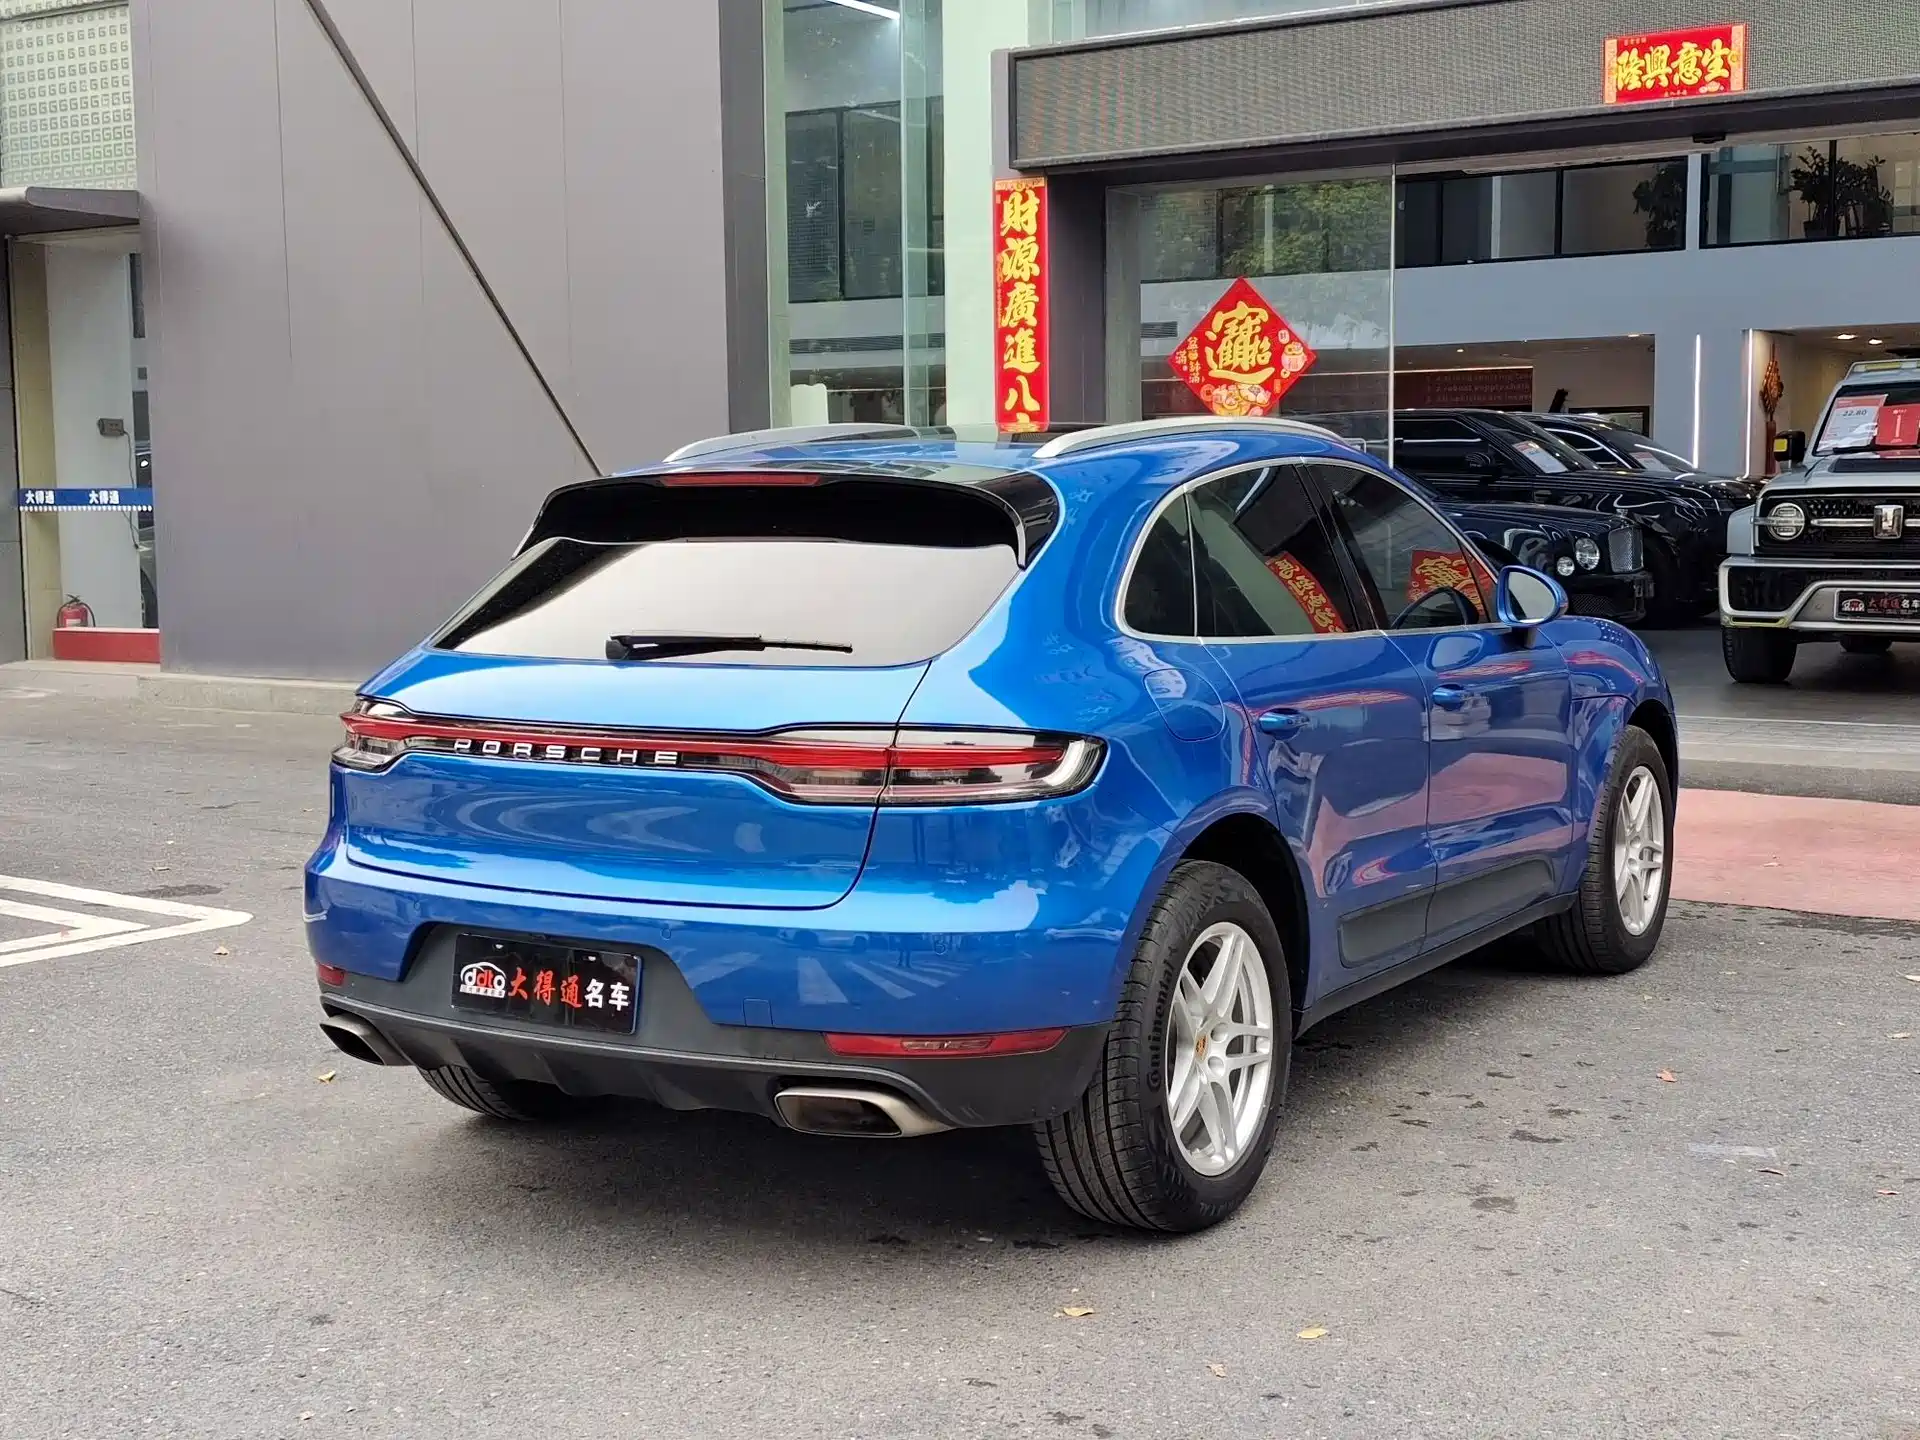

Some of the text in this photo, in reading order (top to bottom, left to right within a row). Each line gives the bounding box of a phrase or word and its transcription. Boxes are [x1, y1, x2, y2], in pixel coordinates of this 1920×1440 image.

[25, 490, 55, 504] 大得通
[88, 490, 120, 504] 大得通
[453, 738, 678, 765] PORSCHE
[1147, 958, 1175, 1092] Continental
